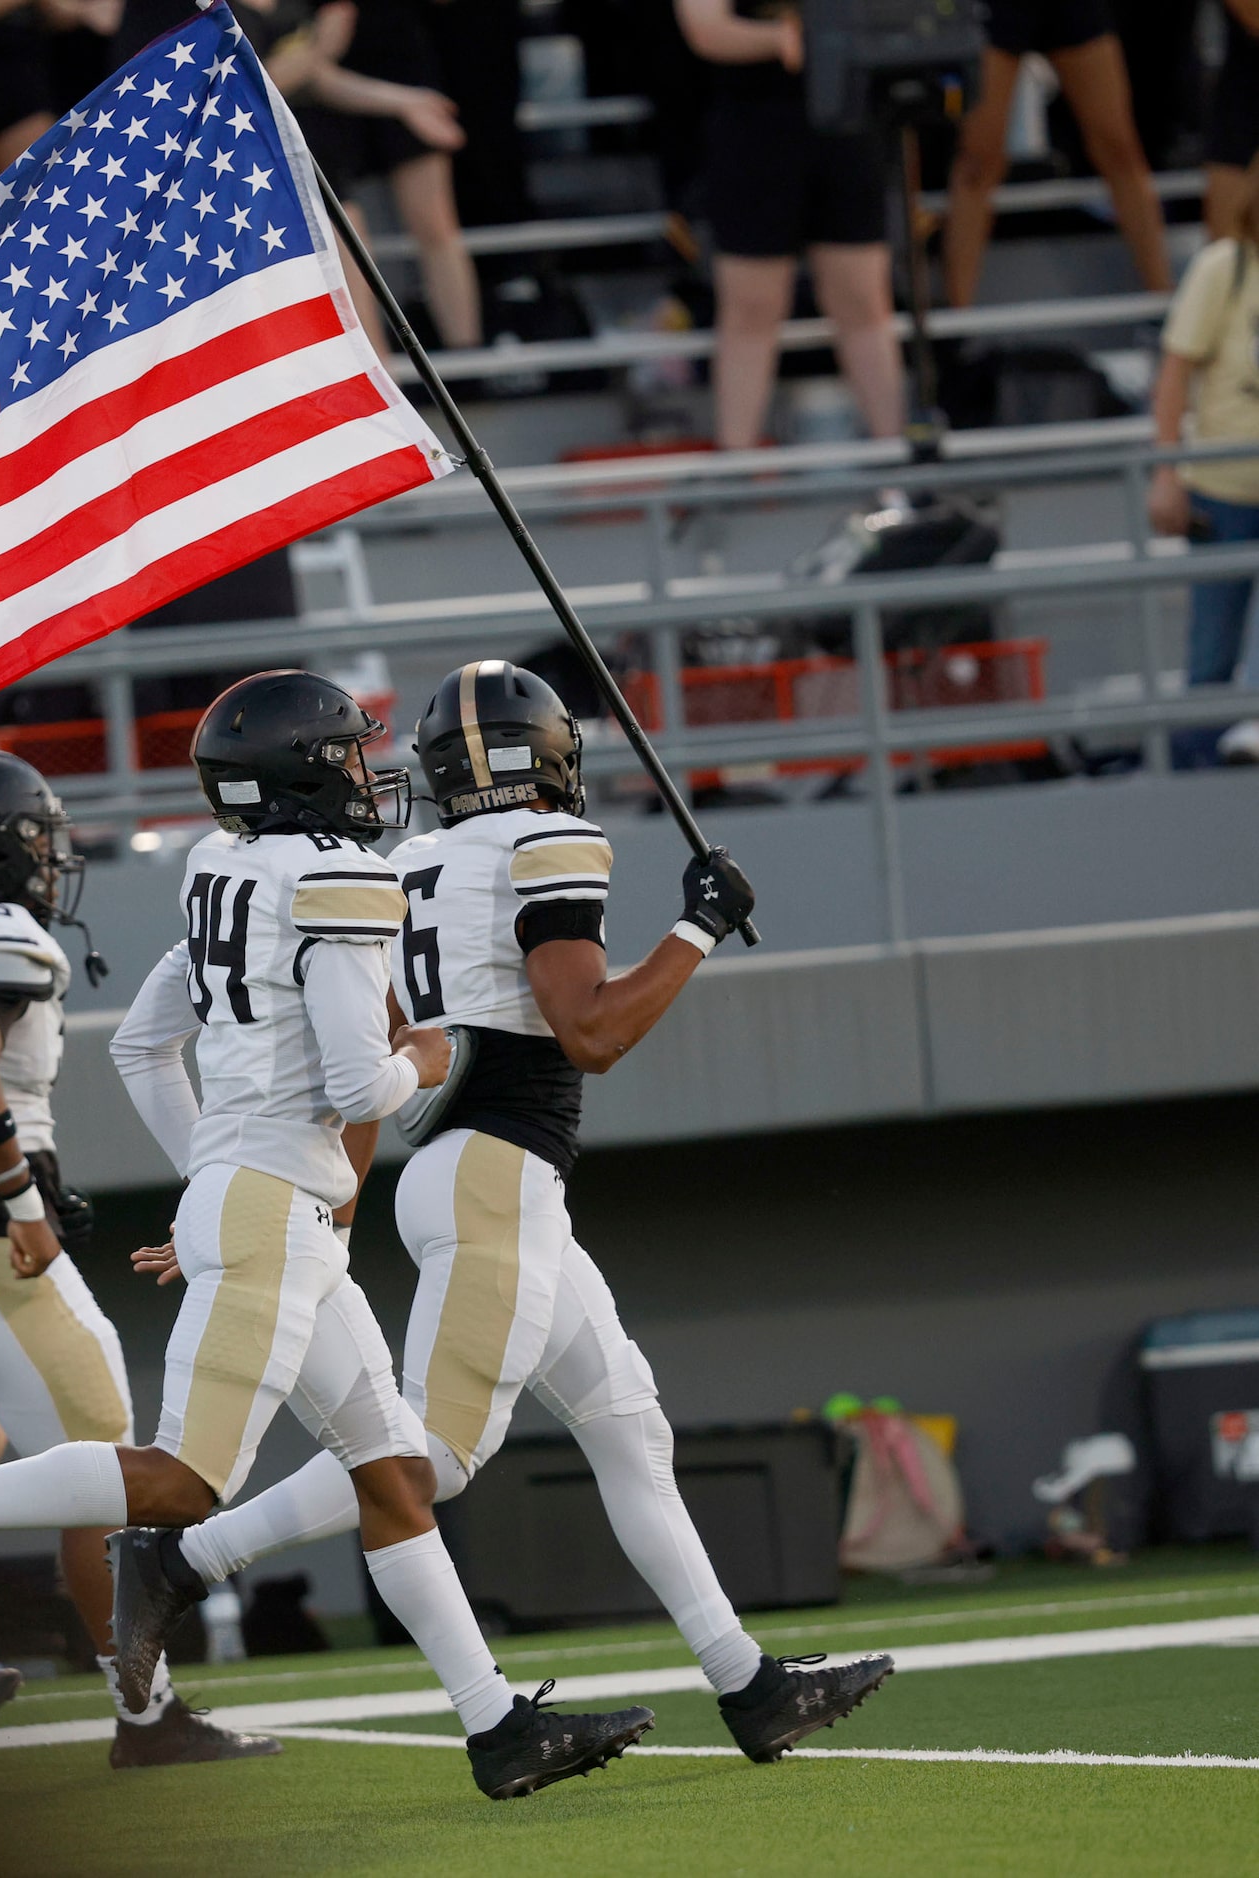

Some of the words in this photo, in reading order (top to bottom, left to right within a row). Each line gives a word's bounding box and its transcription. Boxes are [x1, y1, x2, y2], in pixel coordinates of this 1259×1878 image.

[451, 783, 539, 815] PANTHERS
[187, 872, 260, 1025] 84
[402, 864, 446, 1023] 6
